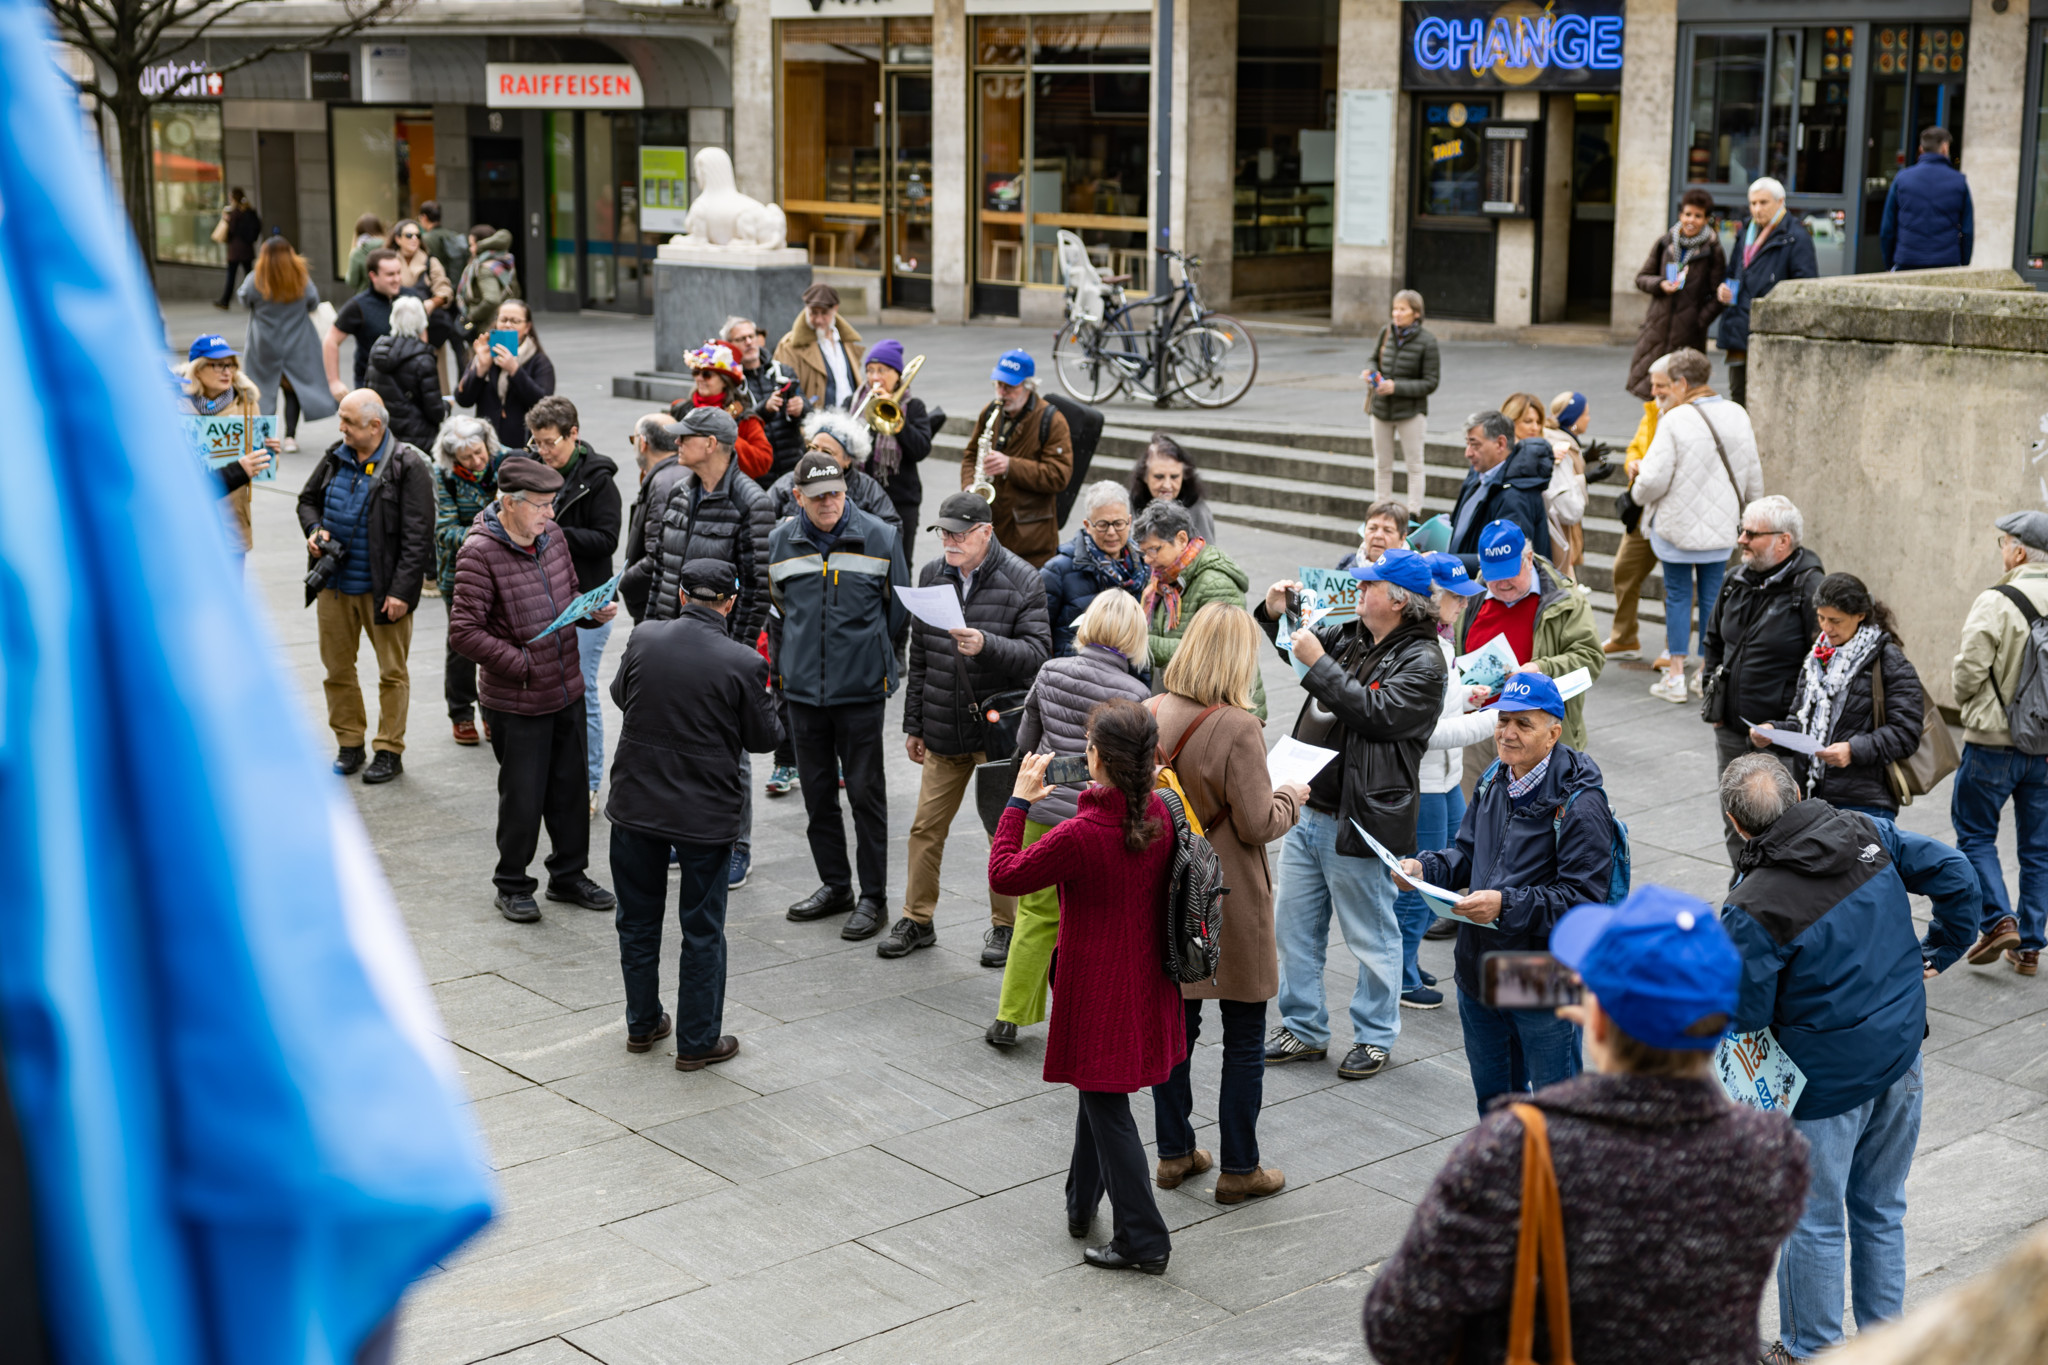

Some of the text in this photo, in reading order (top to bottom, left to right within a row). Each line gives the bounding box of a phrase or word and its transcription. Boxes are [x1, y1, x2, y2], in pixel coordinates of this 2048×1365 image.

[1414, 14, 1623, 71] CHANGE
[499, 74, 631, 96] RAIFFEISEN
[206, 422, 244, 436] AVS
[1485, 544, 1511, 557] AVIVO
[1324, 577, 1358, 592] AVS
